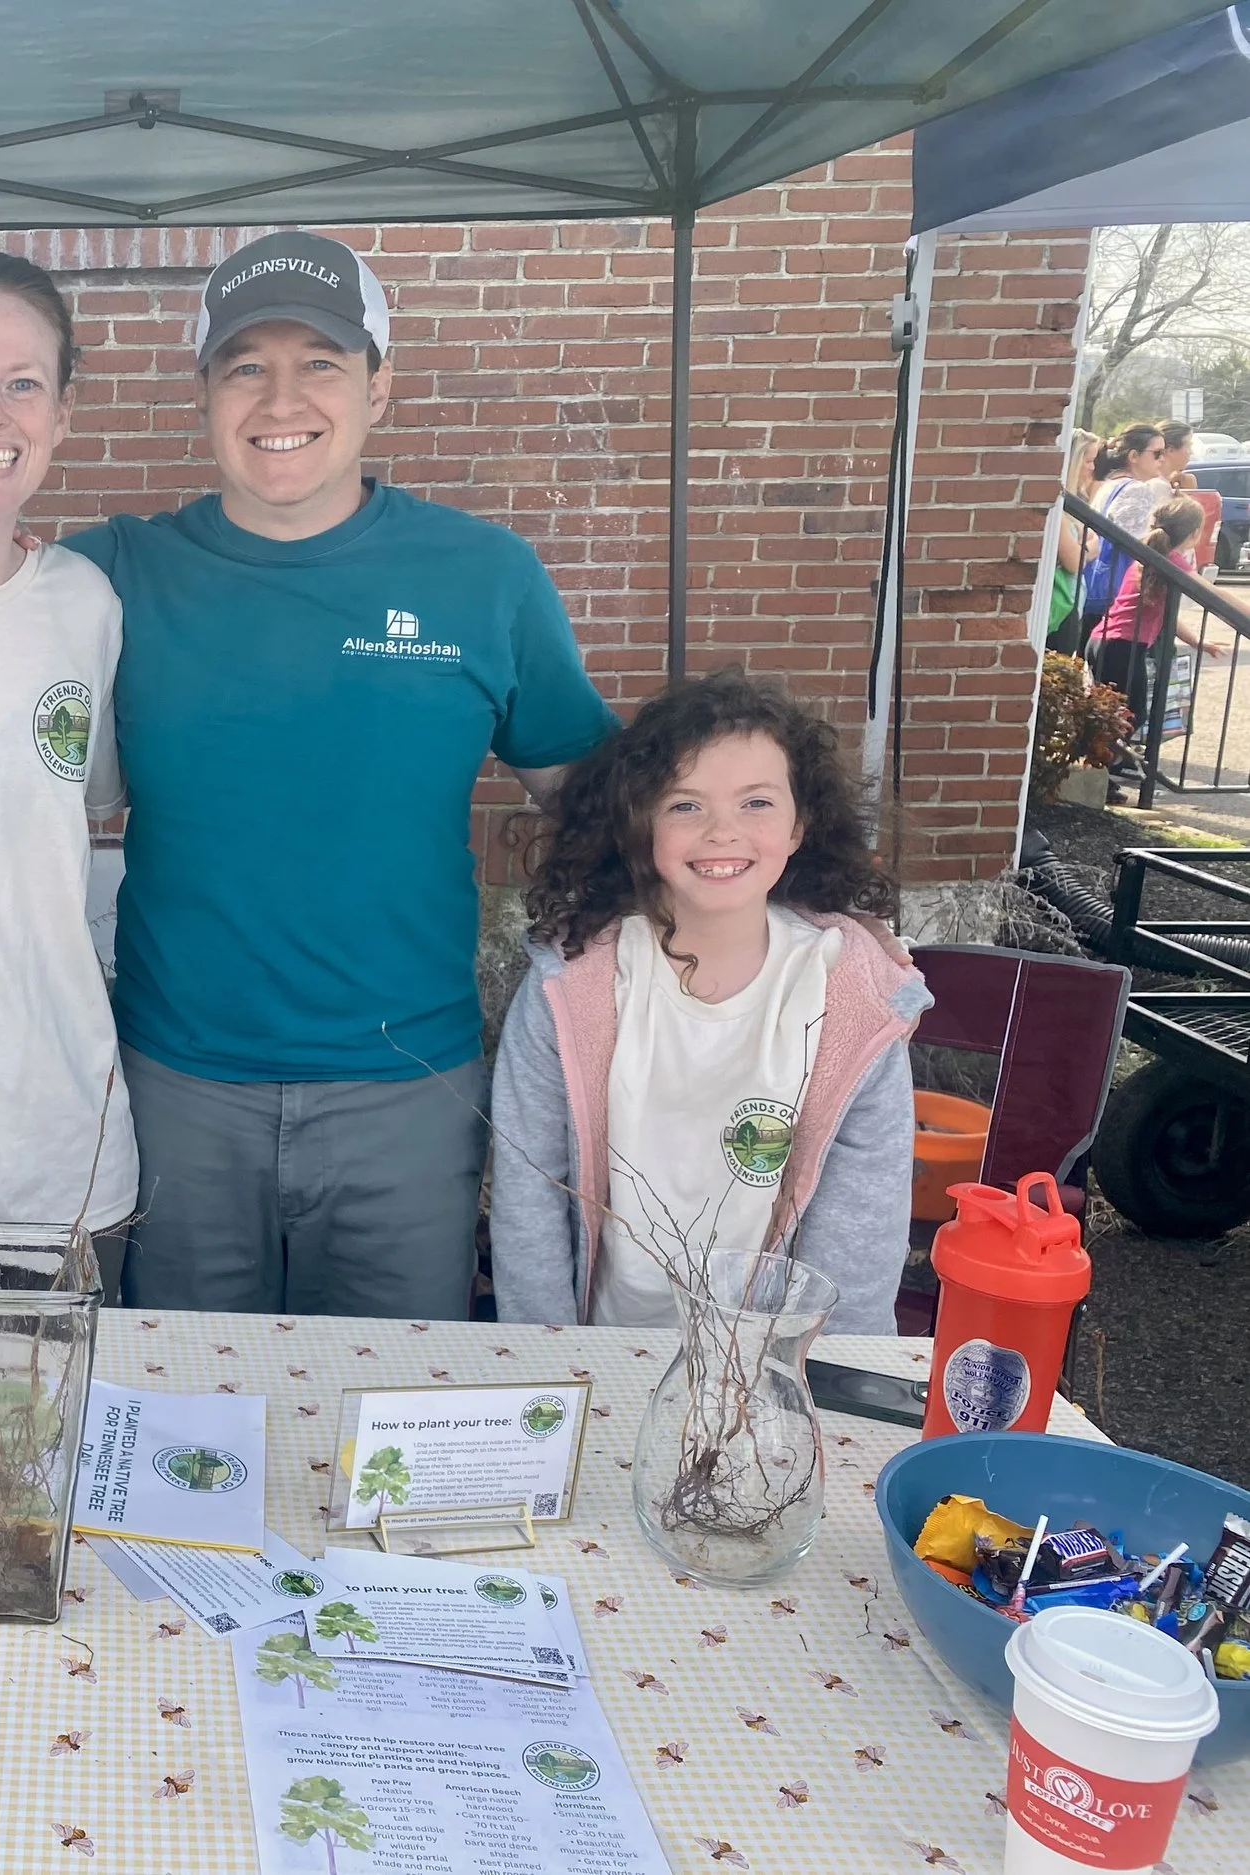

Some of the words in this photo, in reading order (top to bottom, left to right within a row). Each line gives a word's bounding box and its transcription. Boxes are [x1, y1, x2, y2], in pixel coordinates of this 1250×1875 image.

[221, 258, 340, 299] NOLENSVILLE
[342, 637, 461, 657] Allen&Hoshall
[43, 685, 83, 710] FRIENDS
[41, 742, 85, 777] NOLENSVILL
[730, 1103, 776, 1123] FRIENDS
[726, 1151, 780, 1183] NOLENSVILLE
[964, 1361, 990, 1372] JUNIOR
[104, 1405, 120, 1426] FOR
[954, 1391, 1009, 1419] POLICE
[121, 1405, 140, 1448] PLANTED
[371, 1421, 399, 1431] How
[404, 1420, 416, 1430] to
[418, 1419, 451, 1432] plant
[453, 1420, 481, 1431] your
[485, 1418, 512, 1427] tree:
[959, 1411, 989, 1430] 911
[80, 1443, 94, 1466] DAY
[94, 1429, 118, 1483] TENNESSEE
[113, 1459, 132, 1497] NATIVE
[161, 1470, 188, 1487] PARKS
[221, 1454, 242, 1482] FRIENDS
[221, 1481, 233, 1489] OF
[88, 1485, 106, 1511] TREE
[108, 1499, 126, 1523] TREE
[1052, 1530, 1107, 1558] NICKER
[1205, 1541, 1250, 1604] HERSHE
[364, 1585, 399, 1593] plant
[402, 1587, 431, 1595] your
[278, 1730, 308, 1739] These
[311, 1732, 342, 1741] native
[374, 1736, 396, 1745] help
[457, 1742, 482, 1751] local
[484, 1745, 505, 1753] tree
[320, 1741, 358, 1751] canopy
[383, 1745, 423, 1755] support
[426, 1748, 468, 1758] wildlife.
[529, 1743, 567, 1755] FRIENDS
[570, 1748, 584, 1757] OF
[294, 1748, 327, 1756] Thank
[351, 1751, 365, 1759] for
[369, 1753, 412, 1763] planting
[438, 1757, 457, 1766] and
[460, 1760, 500, 1770] helping
[317, 1758, 381, 1769] Nolensville's
[384, 1763, 412, 1772] parks
[439, 1767, 469, 1776] green
[472, 1770, 511, 1780] spaces.
[531, 1768, 582, 1789] NOLENSVILLE
[1011, 1739, 1045, 1780] JUST
[1095, 1798, 1152, 1819] LOVE
[360, 1796, 412, 1804] understory
[446, 1784, 490, 1793] American
[492, 1788, 521, 1796] Beech
[461, 1794, 487, 1803] Large
[490, 1797, 518, 1805] native
[555, 1793, 601, 1801] American
[466, 1803, 514, 1813] hardwood
[555, 1802, 606, 1811] Hornbeam
[558, 1811, 586, 1819] Small
[588, 1812, 617, 1820] native
[1030, 1783, 1070, 1812] COFFEE
[1074, 1807, 1106, 1827] CAFE
